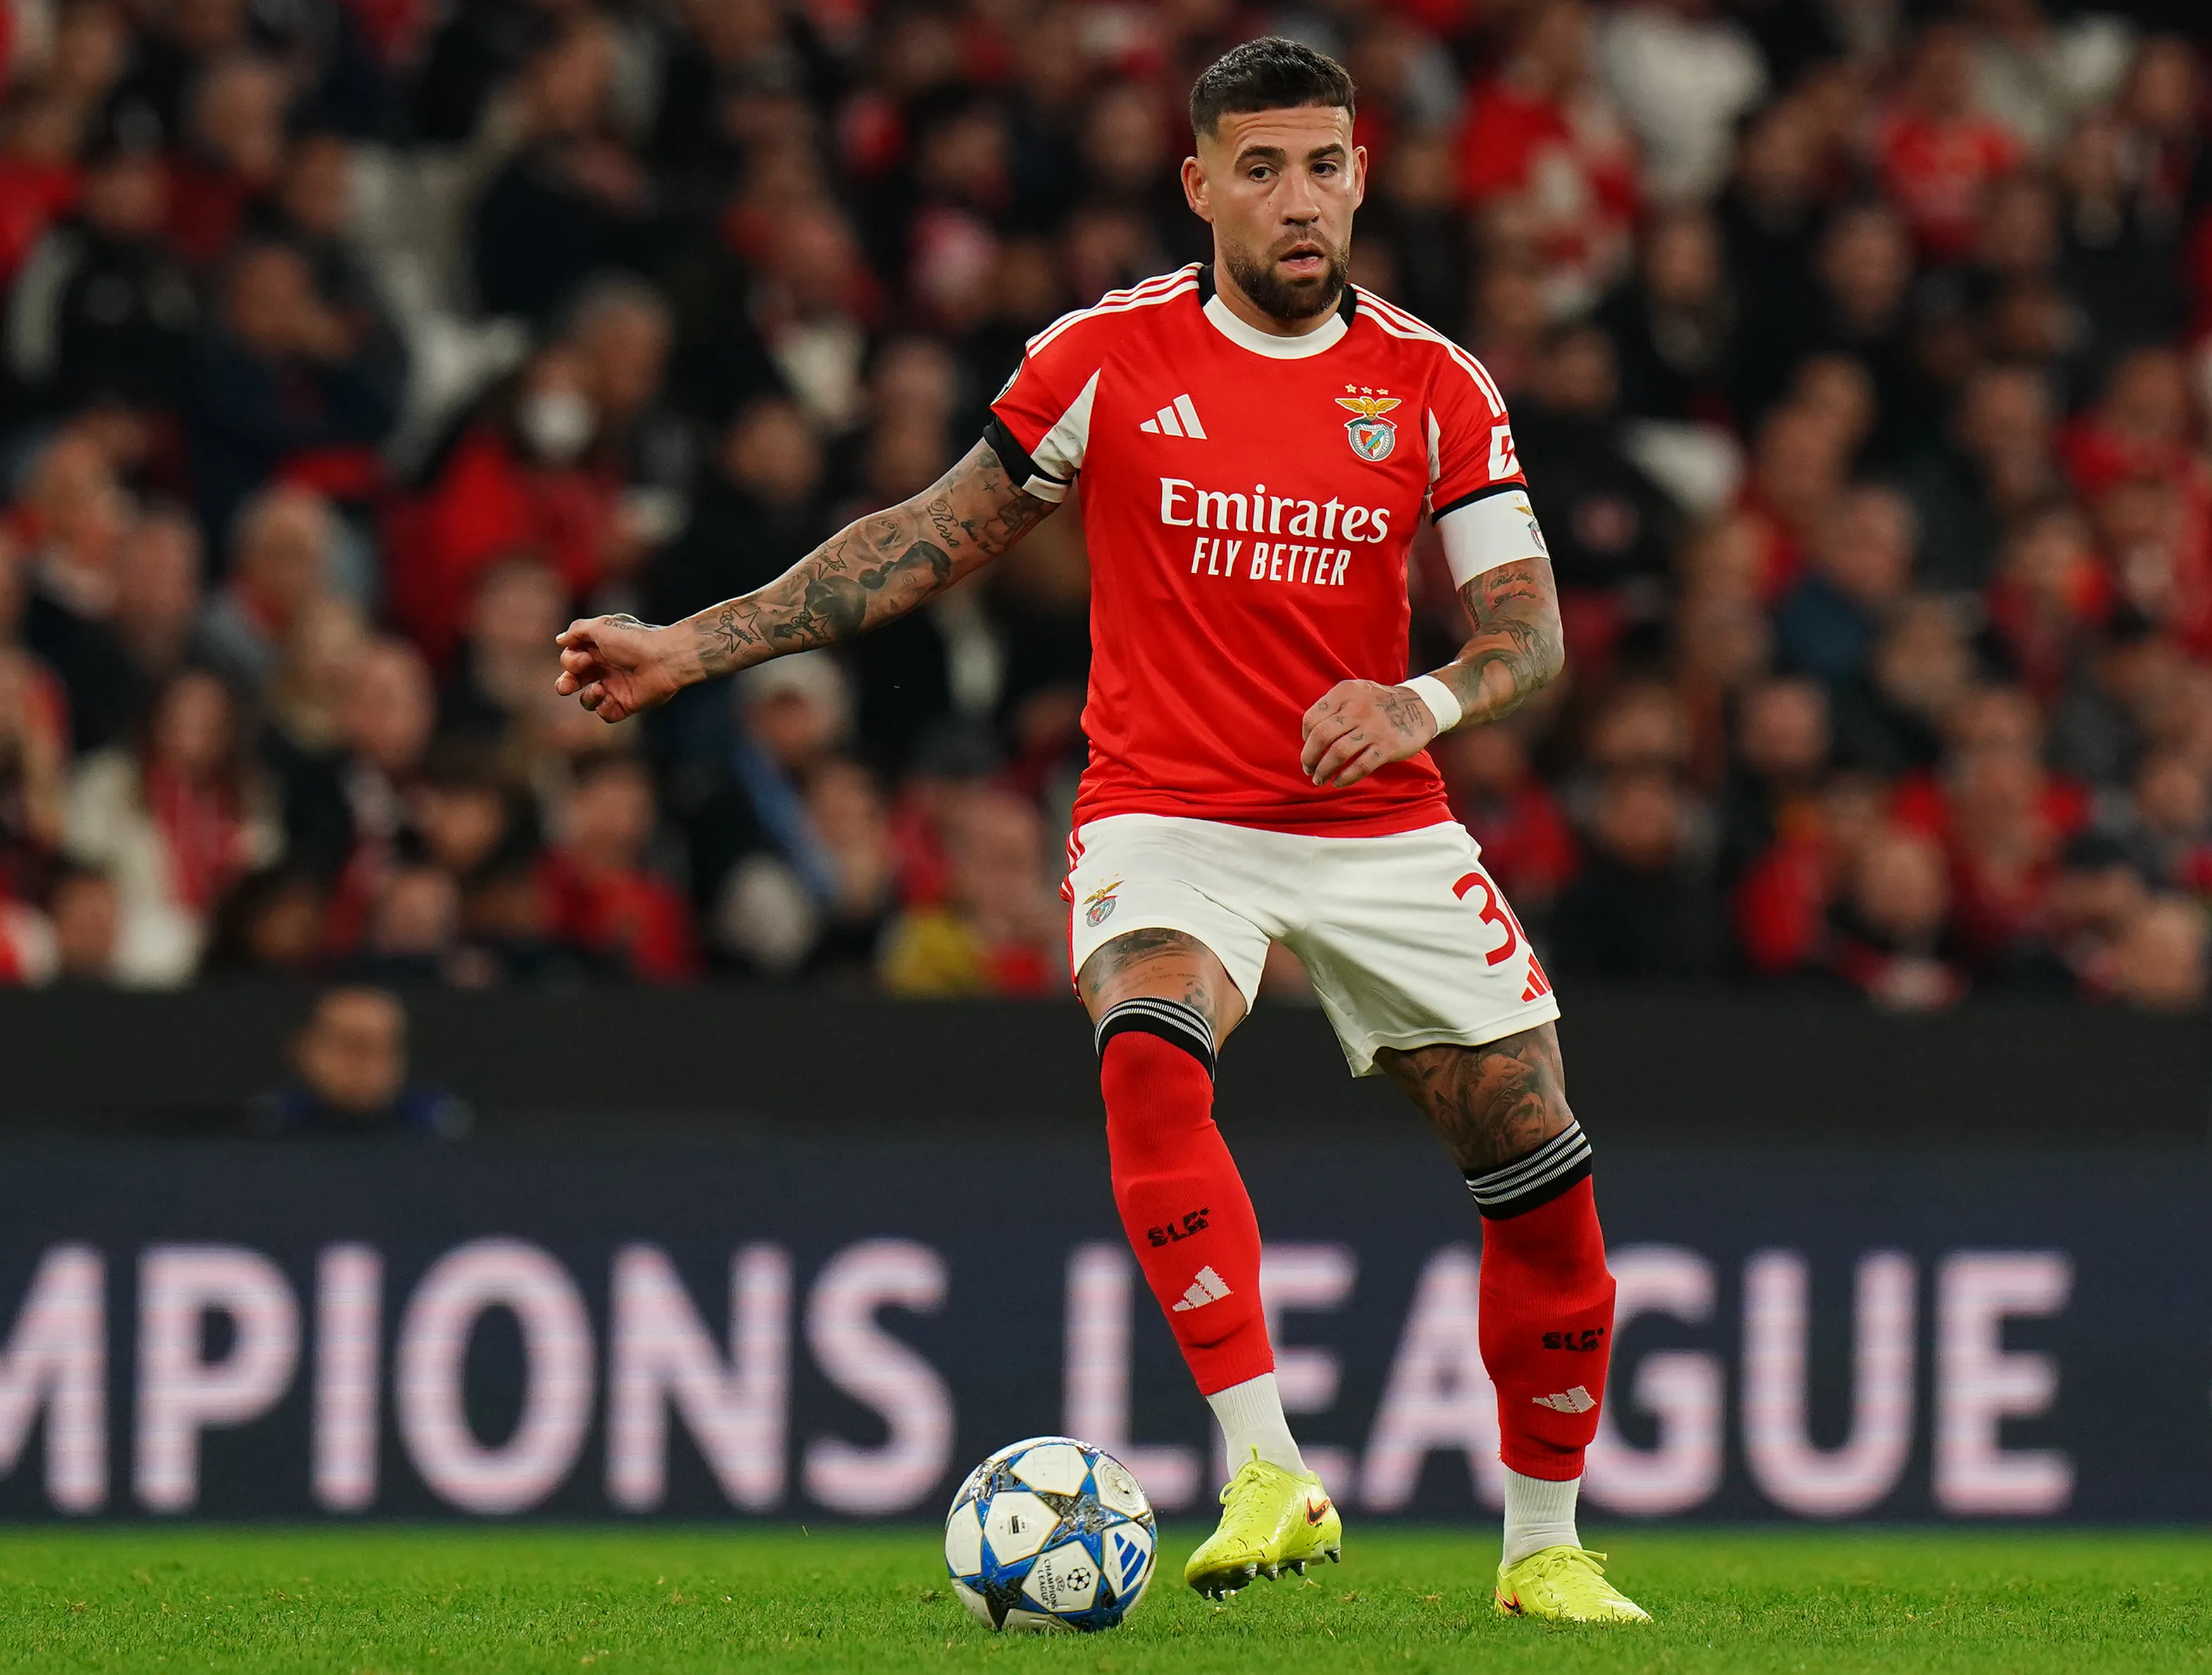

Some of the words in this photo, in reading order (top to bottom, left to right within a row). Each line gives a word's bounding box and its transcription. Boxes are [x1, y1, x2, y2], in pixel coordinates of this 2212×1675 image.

[1160, 477, 1391, 544] Emirates
[1191, 537, 1241, 577] FLY
[1249, 542, 1351, 586] BETTER
[1452, 871, 1530, 967] 3
[1064, 1243, 2076, 1516] LEAGUE
[1037, 1570, 1049, 1605] LEAGUE
